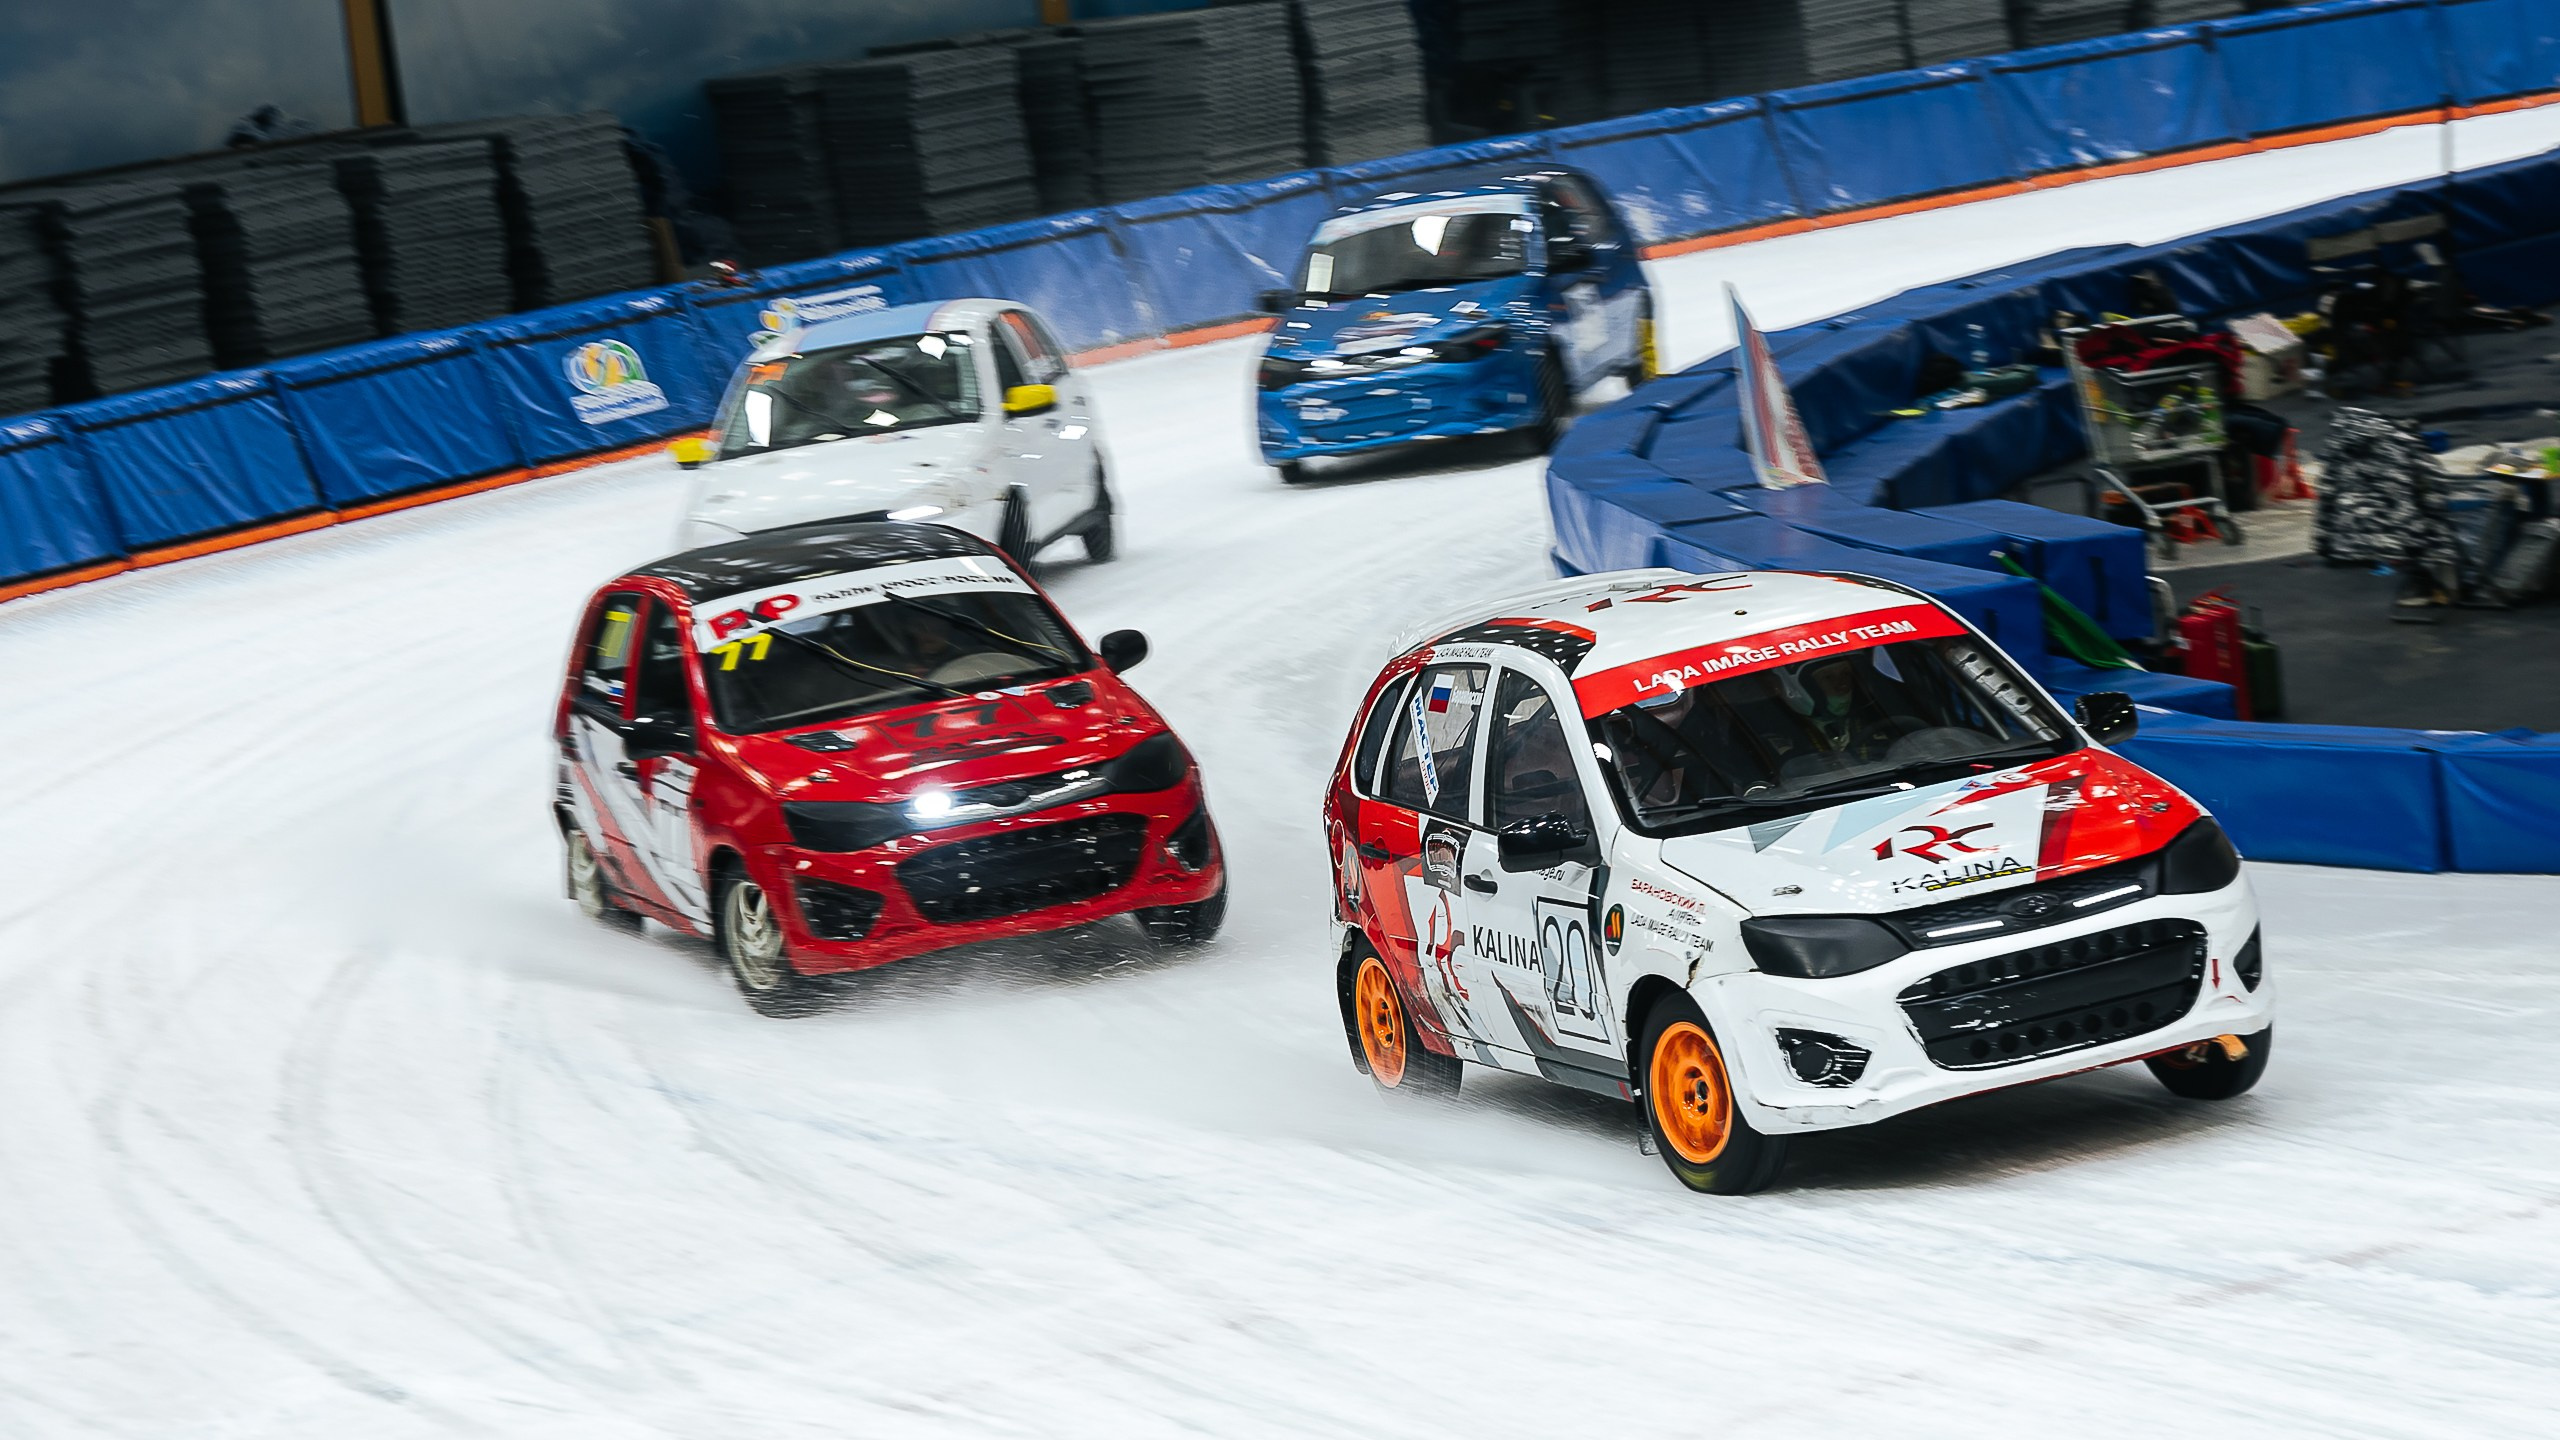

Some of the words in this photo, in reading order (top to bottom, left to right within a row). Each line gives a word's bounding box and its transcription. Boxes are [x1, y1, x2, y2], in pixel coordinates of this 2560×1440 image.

[1632, 664, 1701, 693] LADA
[1702, 645, 1780, 674] IMAGE
[1778, 631, 1849, 659] RALLY
[1849, 619, 1917, 643] TEAM
[887, 702, 1004, 738] 77
[1414, 697, 1439, 792] МАСТЕР
[1890, 857, 2022, 893] KALINA
[1472, 924, 1542, 974] KALINA
[1647, 918, 1669, 937] IMAGE
[1667, 926, 1690, 944] RALLY
[1688, 932, 1715, 952] TEAM
[1543, 915, 1596, 1021] 20
